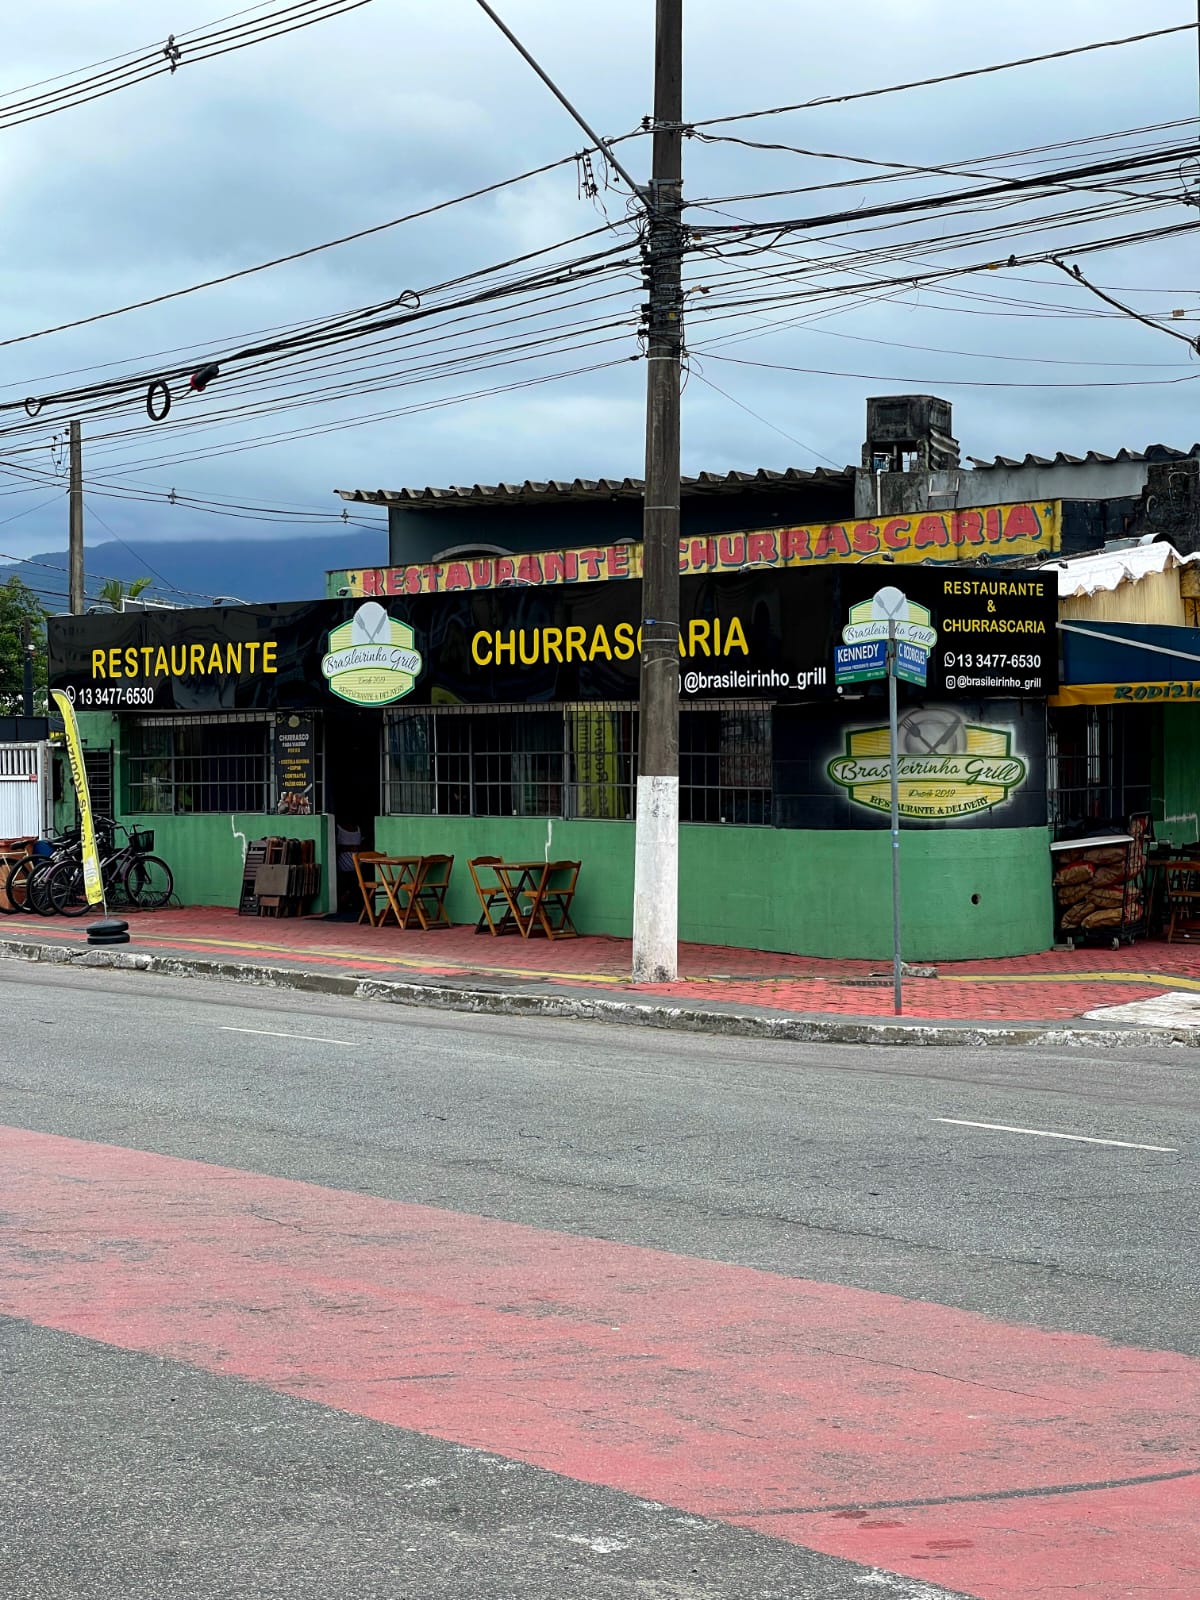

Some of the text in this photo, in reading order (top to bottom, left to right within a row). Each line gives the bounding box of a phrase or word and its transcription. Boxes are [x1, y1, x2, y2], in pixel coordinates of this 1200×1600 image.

[362, 545, 630, 597] RESTAURANTE
[943, 580, 1044, 597] RESTAURANTE
[986, 599, 997, 613] &
[908, 625, 935, 643] Grill
[942, 618, 1046, 634] CHURRASCARIA
[471, 616, 749, 666] CHURRASRIA
[898, 643, 904, 657] C
[92, 641, 278, 679] RESTAURANTE
[325, 646, 419, 674] Brasileirinho Grill
[837, 643, 879, 663] KENNEDY
[957, 653, 1042, 669] 13 3477-6530
[684, 666, 827, 693] @brasileirinho_grill
[957, 675, 1042, 690] @brasileirinho_grill
[78, 686, 154, 705] 13 3477-6530
[834, 757, 1017, 786] Brasleirinho Grill
[869, 795, 936, 815] RESAURANTE
[945, 796, 989, 815] DELIVERY
